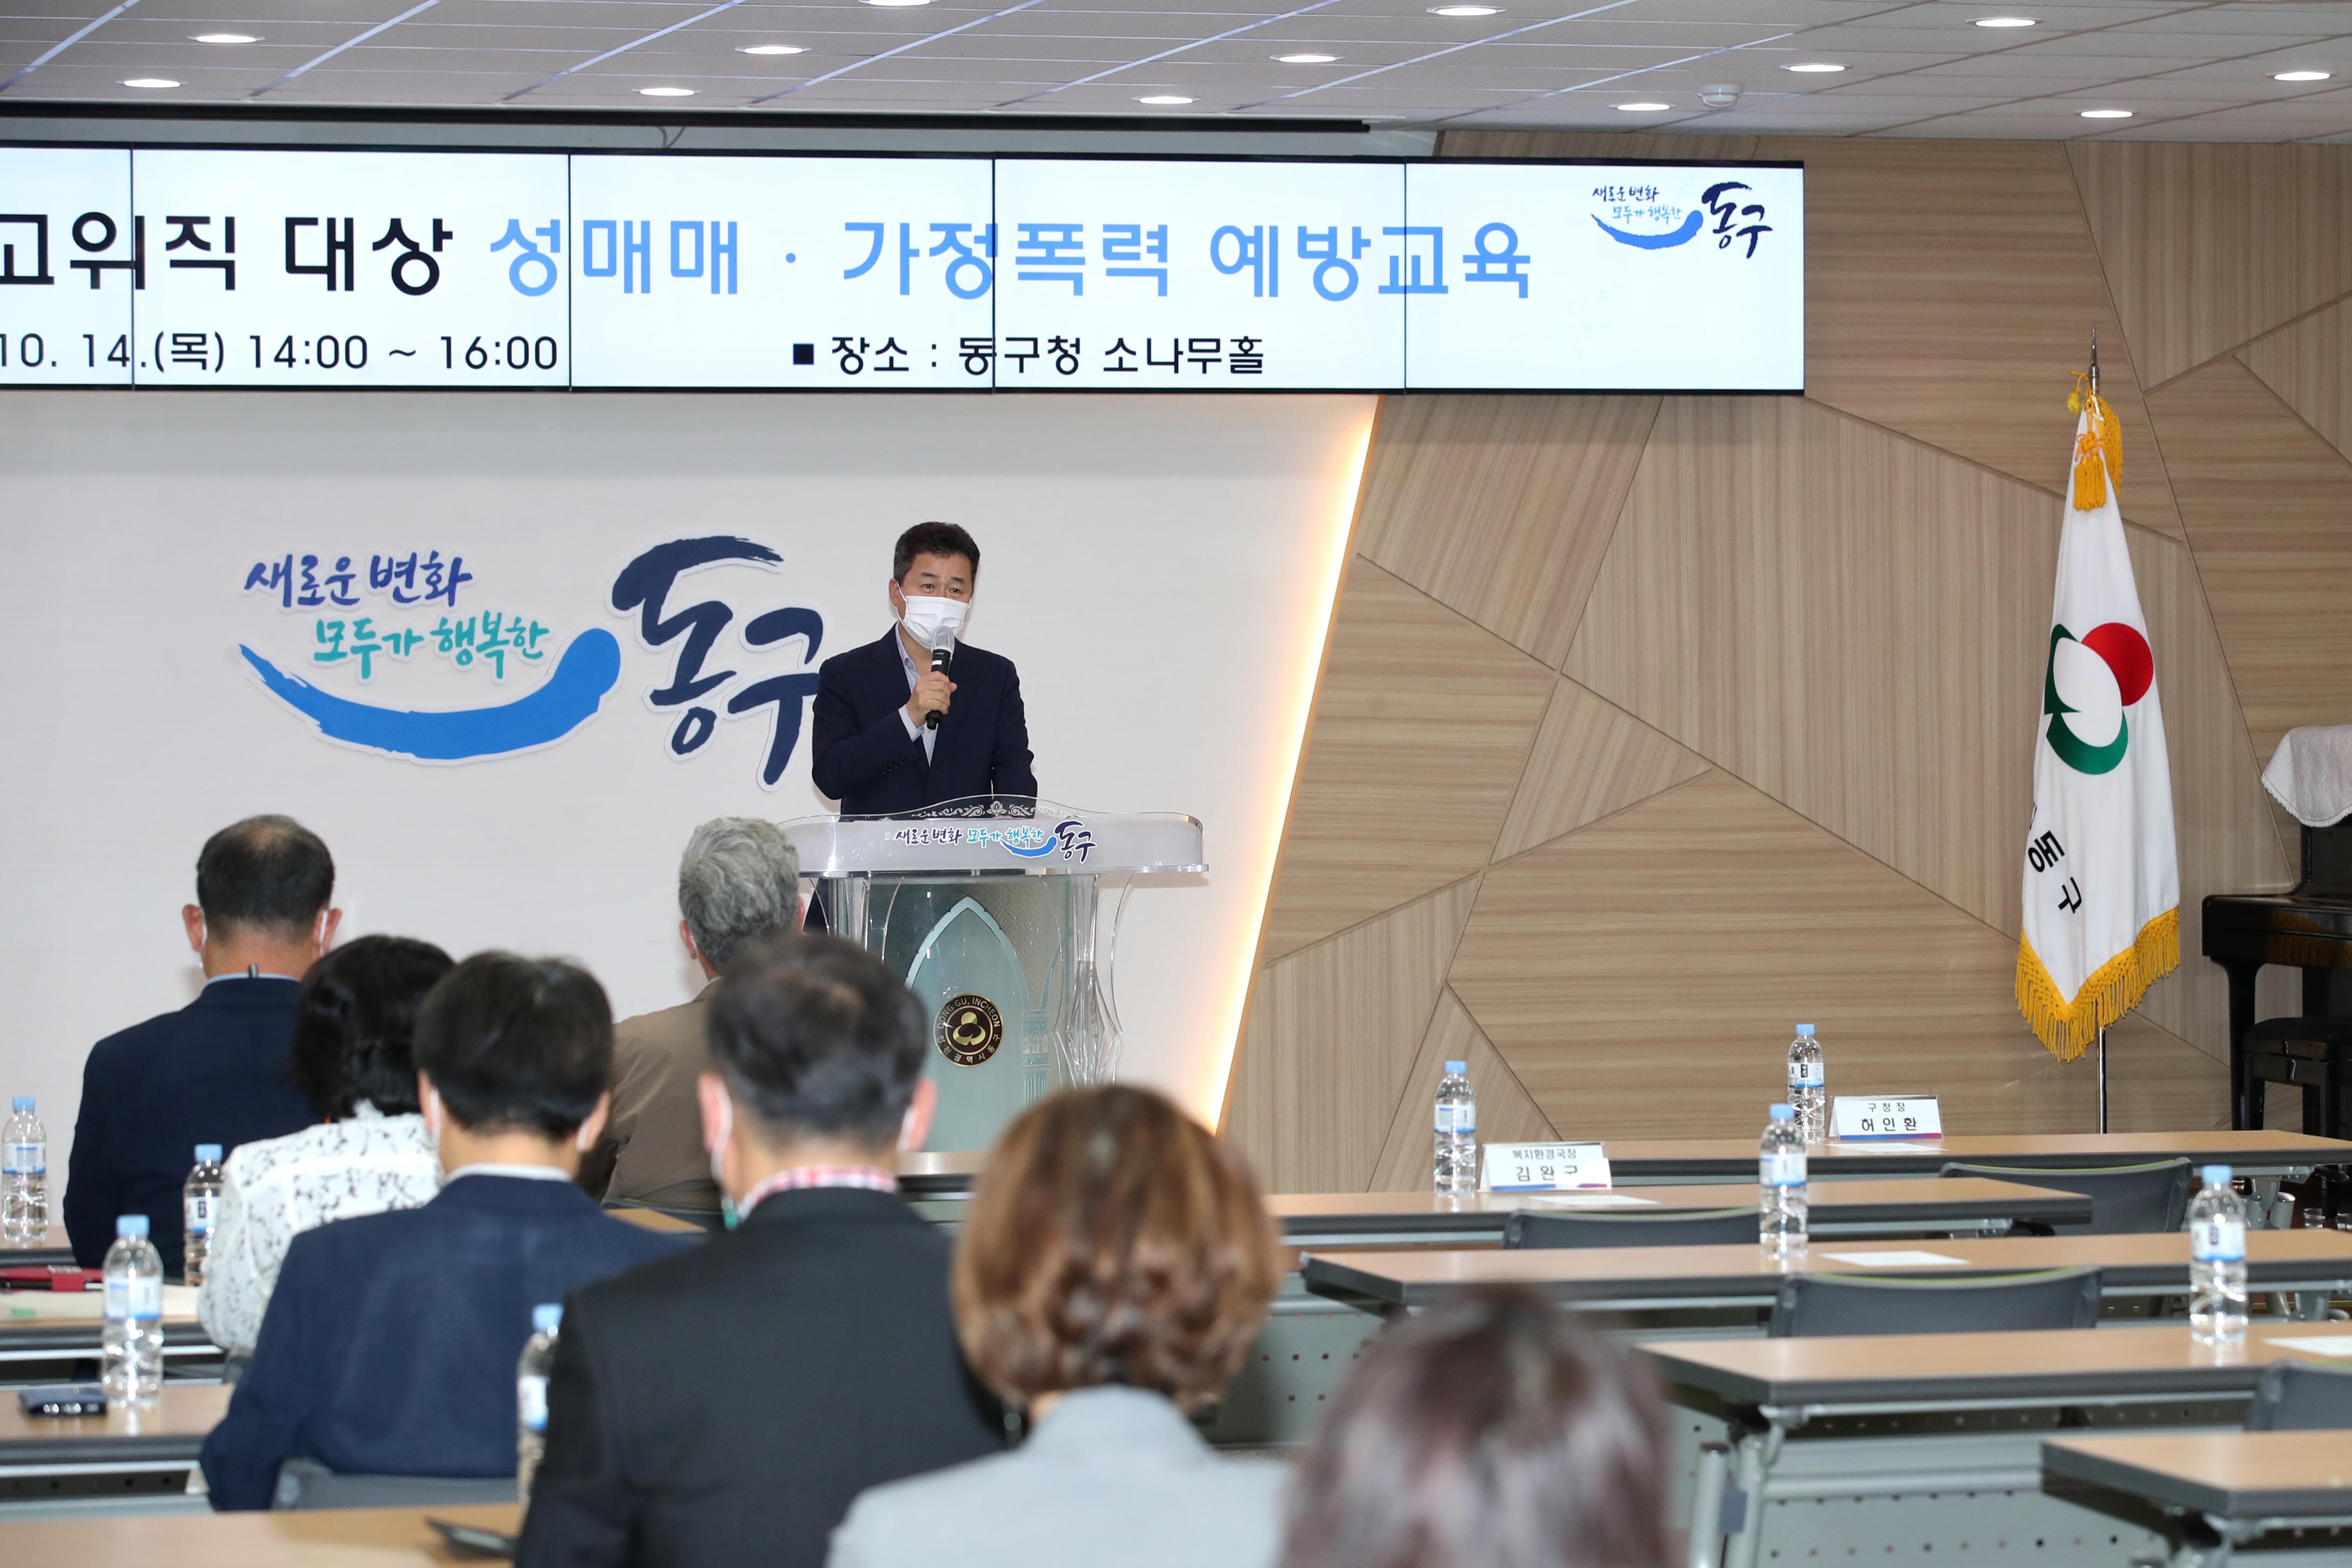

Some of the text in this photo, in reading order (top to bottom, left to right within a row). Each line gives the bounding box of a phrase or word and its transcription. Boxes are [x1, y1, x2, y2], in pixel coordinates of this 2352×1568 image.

[1592, 185, 1660, 202] 새로운 변화
[1612, 203, 1682, 225] 모두가 행복한
[1702, 181, 1773, 259] 동구
[0, 212, 235, 290] 고위직
[285, 217, 453, 296] 대상
[491, 219, 738, 297] 성매매
[844, 222, 1168, 300] 가정폭력
[1210, 222, 1531, 302] 예방교육
[82, 331, 224, 373] 14.(목)
[249, 334, 367, 369] 14:00
[440, 335, 557, 370] 16:00
[831, 337, 909, 375] 장소
[958, 335, 1080, 376] 동구청
[1103, 335, 1264, 374] 소나무홀
[244, 550, 473, 608] 새로운 변화
[313, 611, 550, 680] 모두가 행복한
[611, 535, 823, 787] 동구
[895, 820, 1096, 862] 새로운 변화 모두가 행복한 동구
[2028, 830, 2083, 914] 동구
[937, 1004, 954, 1029] DONG
[972, 997, 1000, 1027] INCHEON
